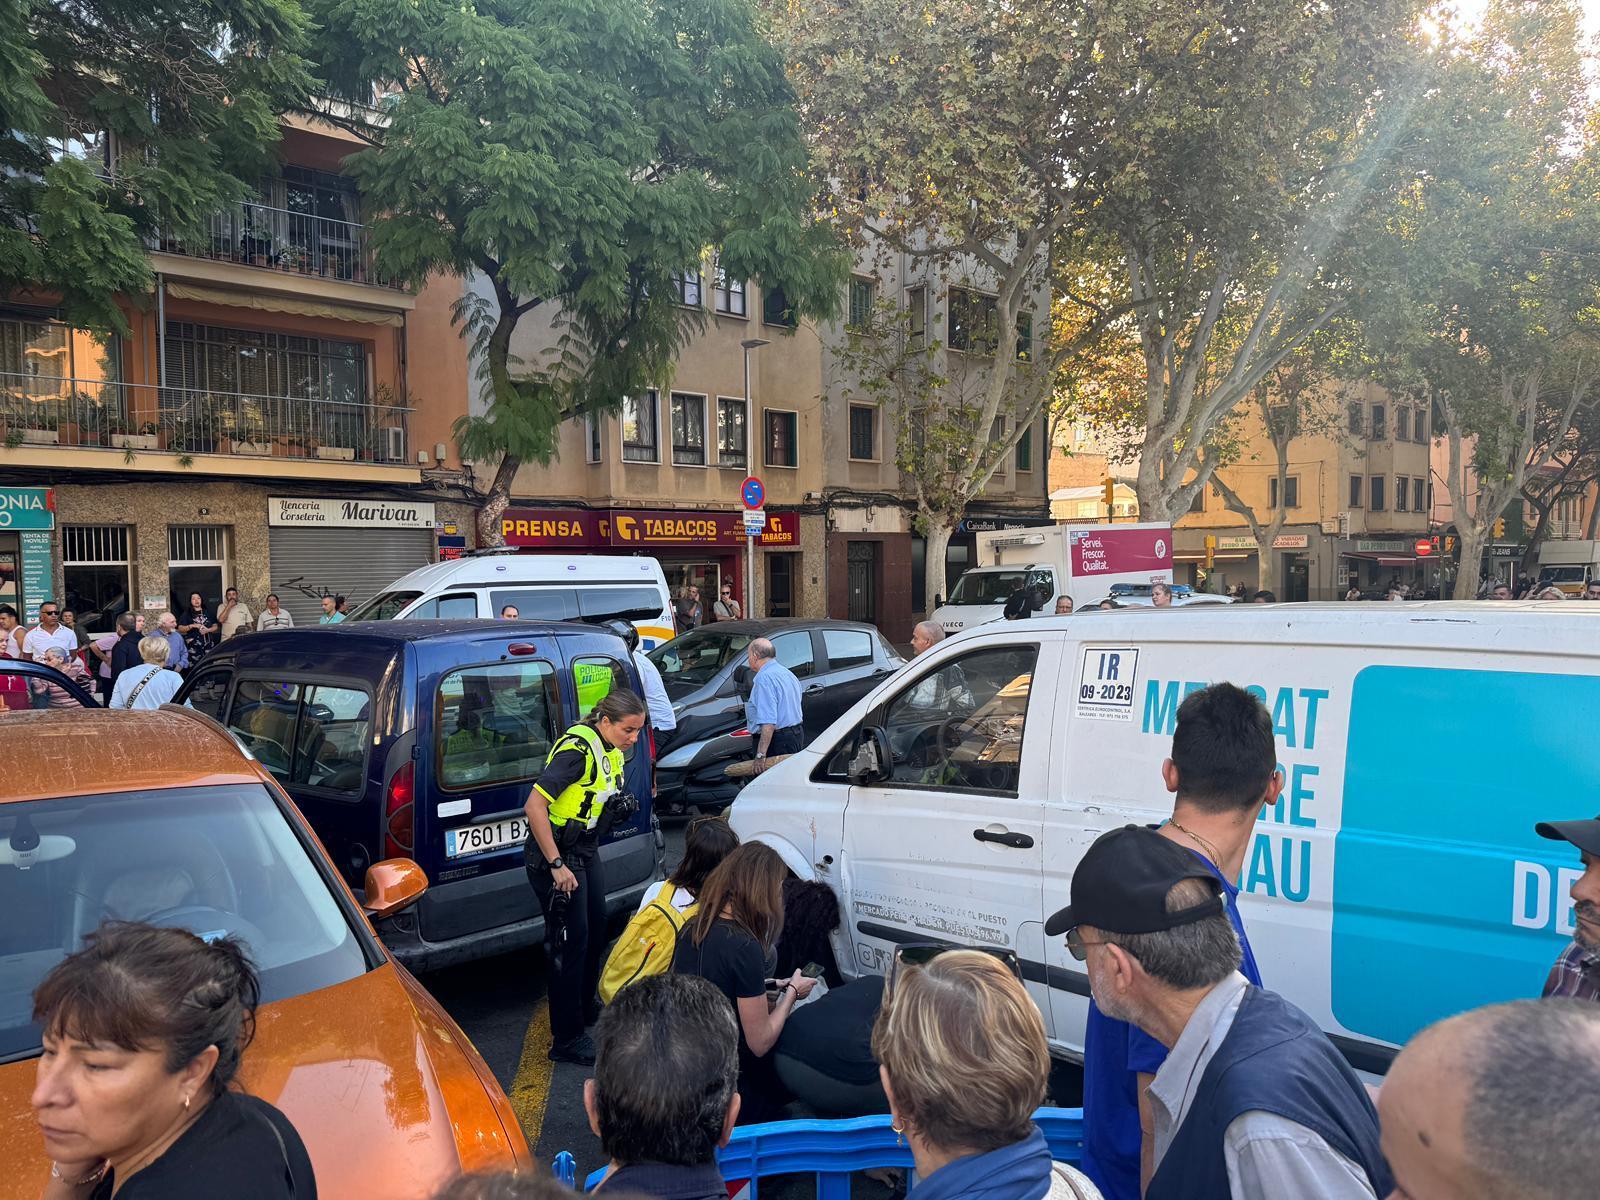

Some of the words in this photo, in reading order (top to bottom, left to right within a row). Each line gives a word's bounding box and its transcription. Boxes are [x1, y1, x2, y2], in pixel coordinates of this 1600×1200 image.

[280, 500, 320, 511] Llenceria
[341, 502, 418, 521] Marivan
[280, 511, 325, 521] Corseteria
[502, 520, 583, 536] PRENSA
[644, 520, 717, 536] TABACOS
[1082, 549, 1106, 559] Frescor.
[1083, 560, 1109, 572] Qualitat.
[1098, 654, 1120, 680] IR
[1142, 680, 1329, 750] MAT
[459, 823, 502, 850] 7601
[510, 818, 529, 840] BX
[978, 913, 1008, 926] PUESTO
